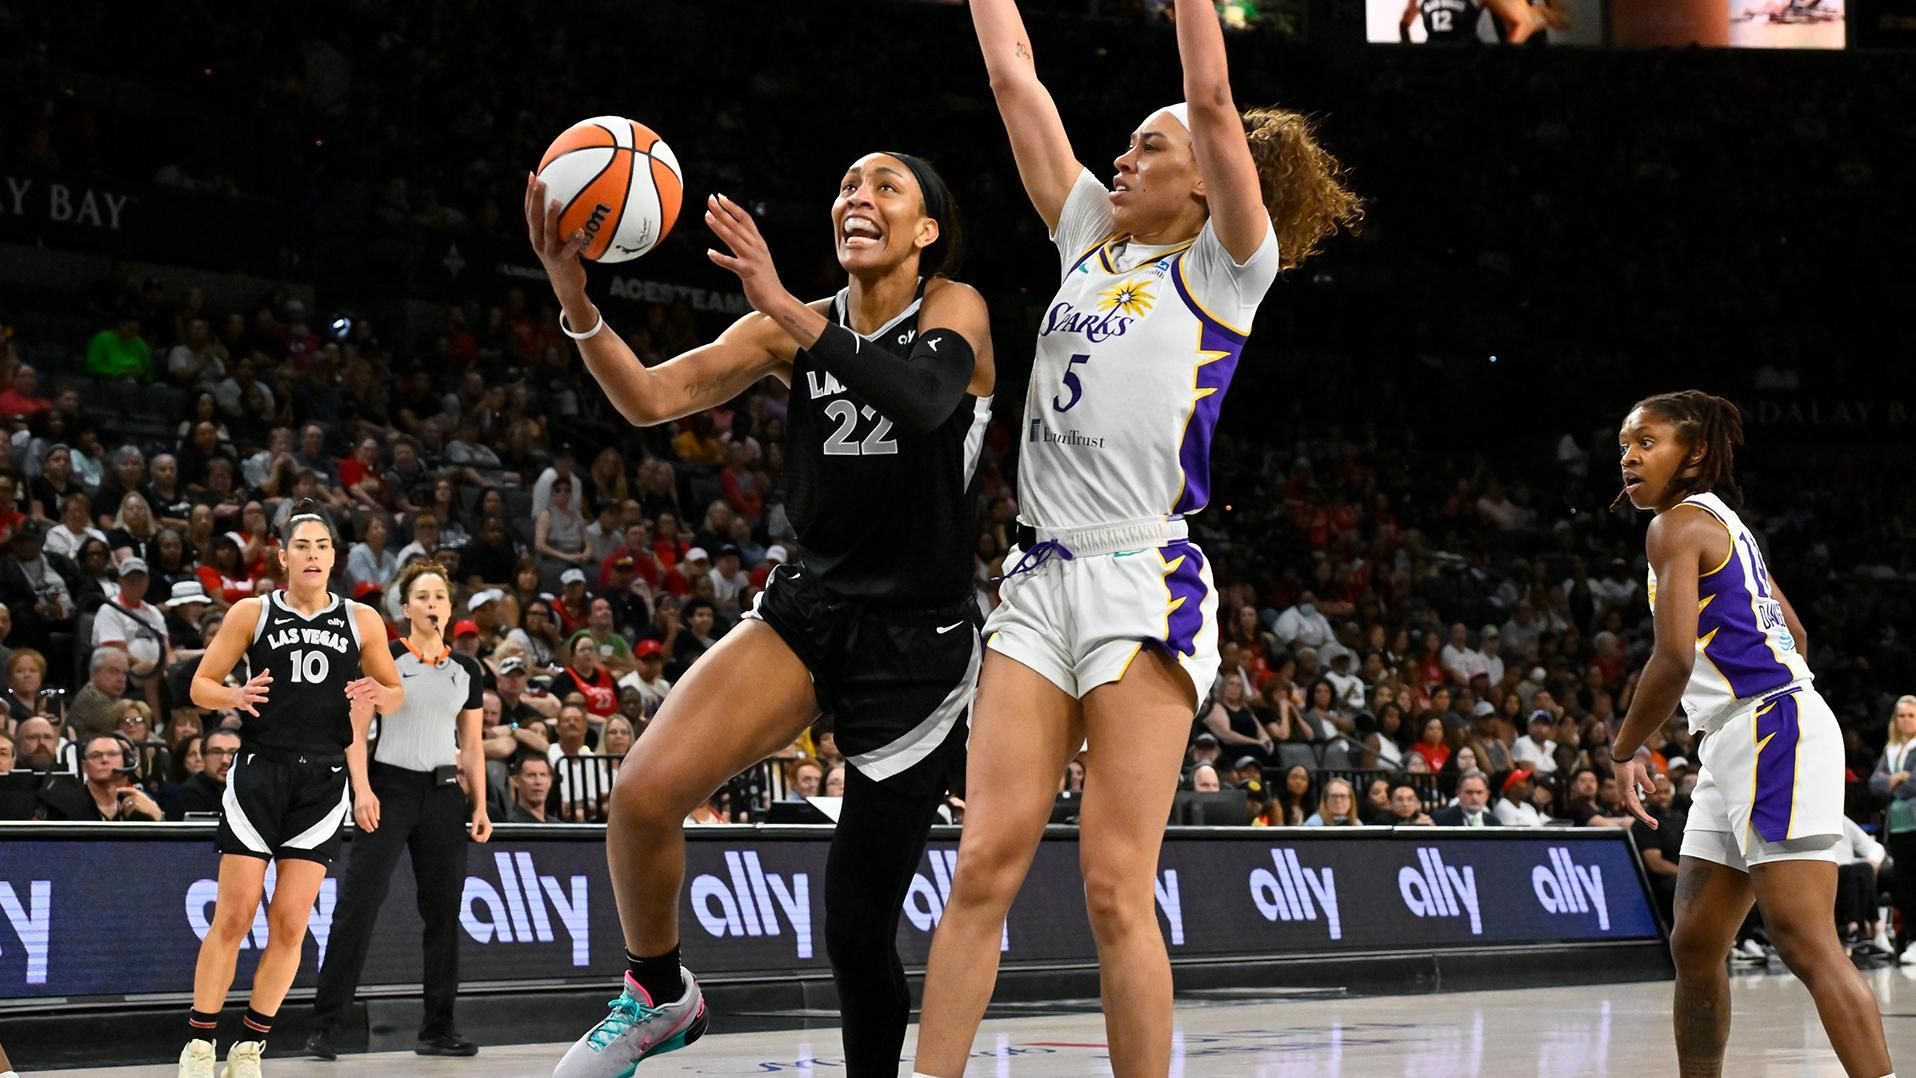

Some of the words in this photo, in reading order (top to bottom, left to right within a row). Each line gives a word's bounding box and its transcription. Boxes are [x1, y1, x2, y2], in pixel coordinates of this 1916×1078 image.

[1430, 9, 1454, 32] 12
[49, 183, 129, 230] BAY
[1053, 354, 1090, 413] 5
[823, 399, 898, 456] 22
[267, 628, 300, 650] LAS
[300, 628, 349, 654] VEGAS
[290, 649, 329, 684] 10
[459, 852, 590, 967] ally
[691, 851, 812, 959] ally
[1249, 848, 1342, 940] ally
[1398, 847, 1483, 935] ally
[1532, 847, 1610, 931] ally
